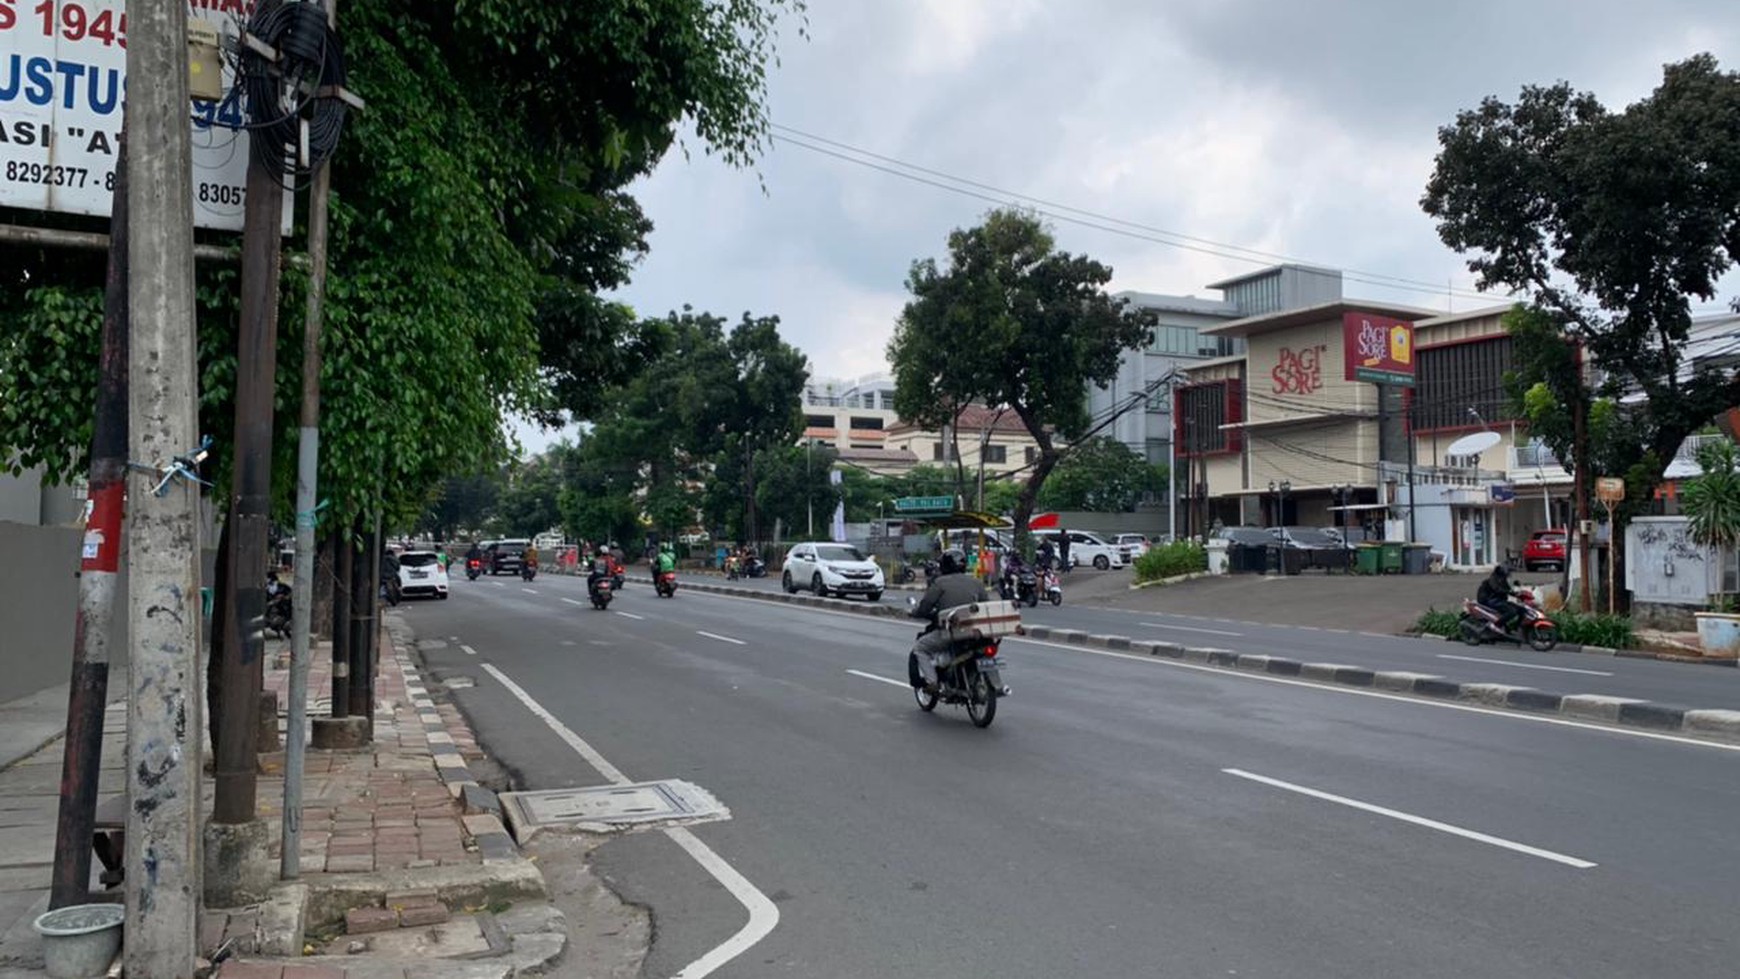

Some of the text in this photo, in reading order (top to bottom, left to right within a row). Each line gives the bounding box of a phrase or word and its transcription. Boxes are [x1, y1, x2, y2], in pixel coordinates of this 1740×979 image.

[0, 54, 127, 115] USTU
[6, 160, 88, 189] 8292377
[199, 183, 247, 205] 8305
[1358, 332, 1387, 360] SORE
[1362, 320, 1386, 343] PAGI
[1279, 345, 1320, 373] PAGI
[1272, 365, 1323, 395] SORE
